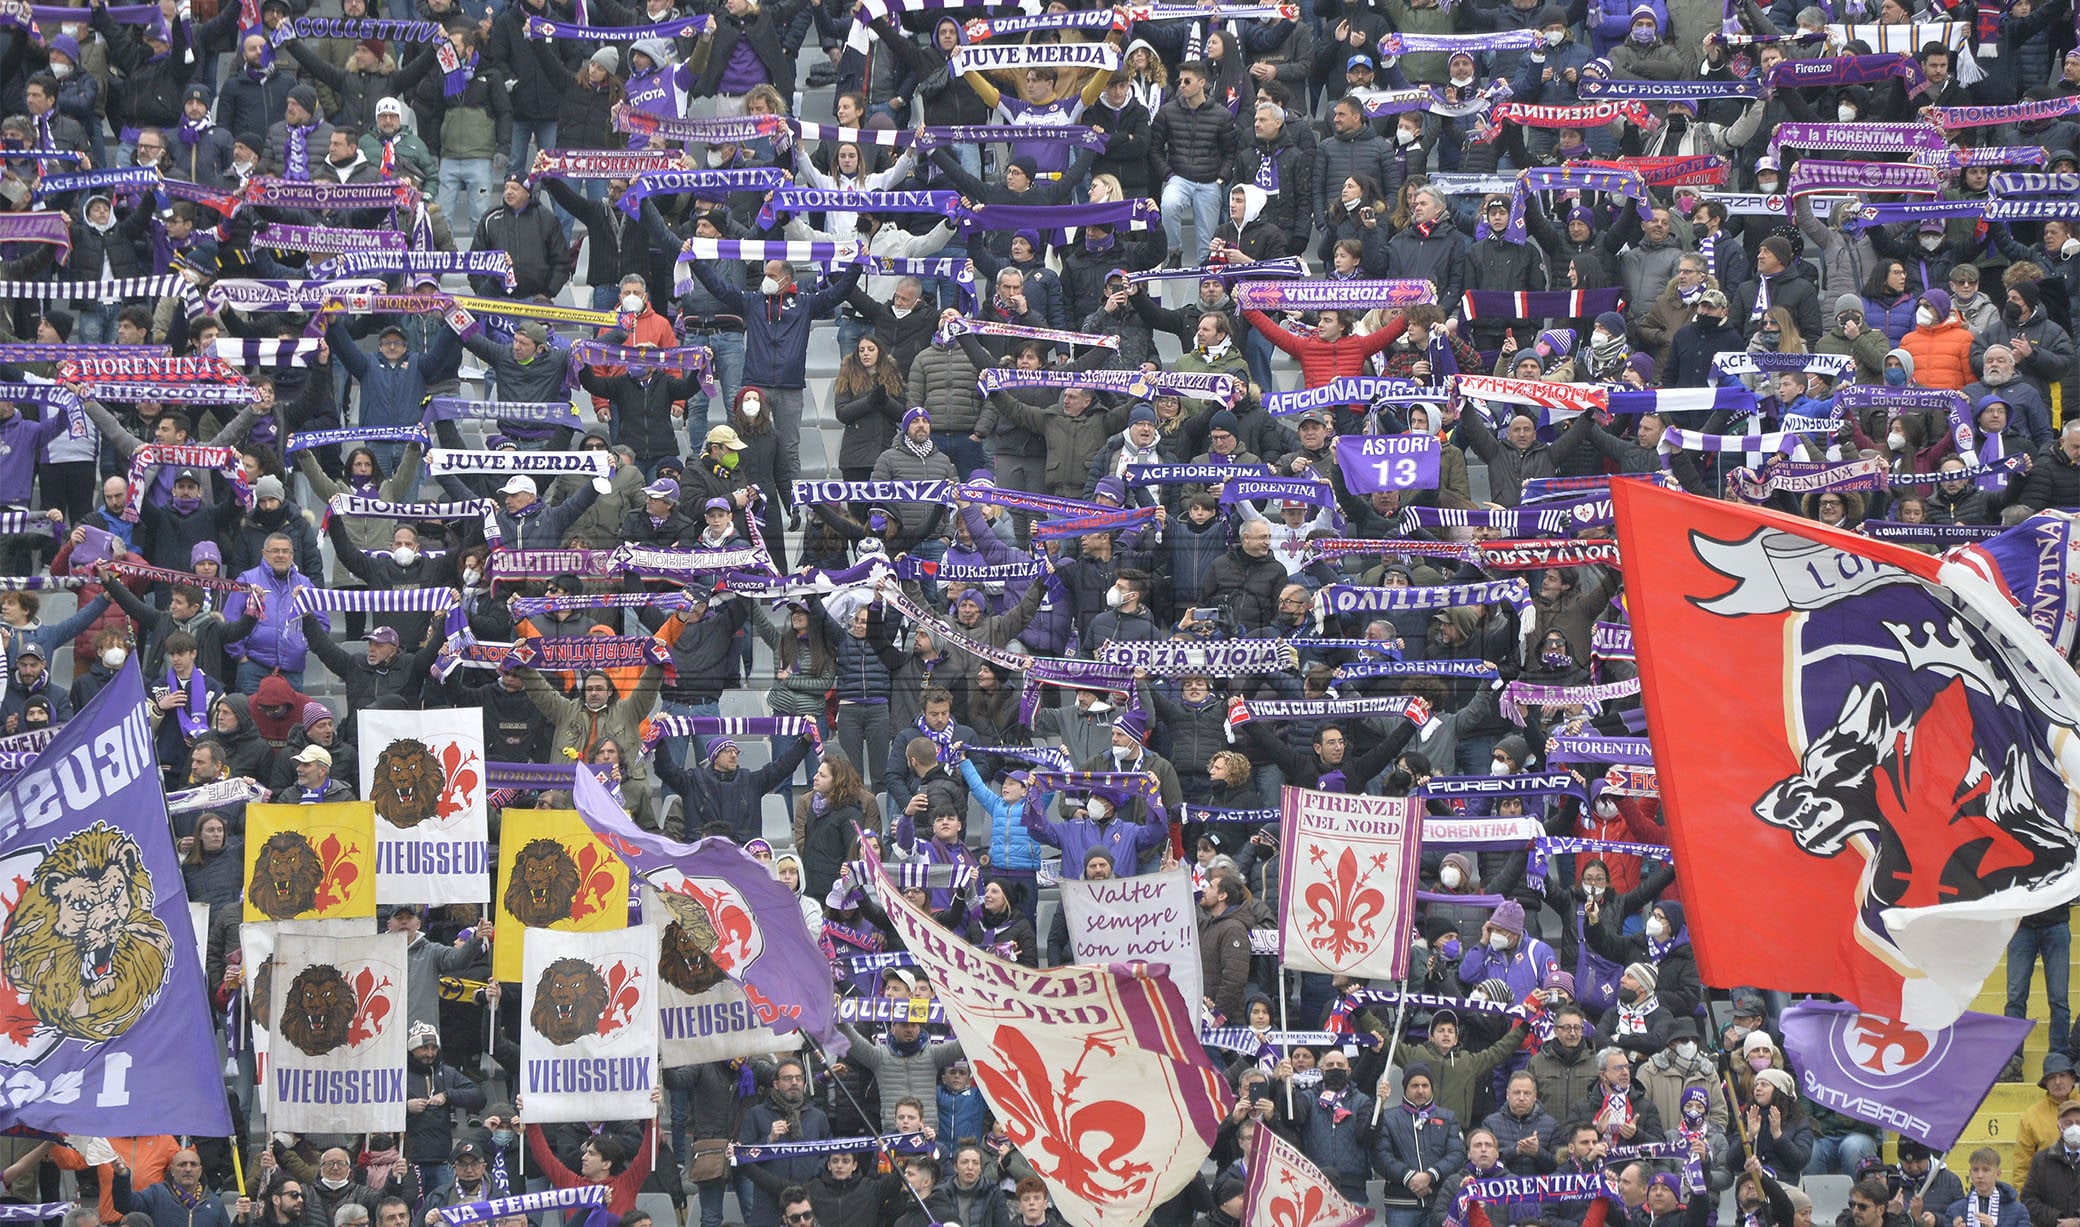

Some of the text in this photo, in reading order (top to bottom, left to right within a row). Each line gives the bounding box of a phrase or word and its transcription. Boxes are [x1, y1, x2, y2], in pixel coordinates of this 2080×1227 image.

[294, 17, 451, 42] COLLETTIV
[961, 44, 1106, 67] JUVE MERDA
[1795, 62, 1832, 74] Firenze
[630, 88, 667, 107] TOYOTA
[1607, 84, 1728, 95] ACF FIORENTINA
[1949, 96, 2072, 124] FIORENTINA
[660, 121, 757, 137] FIORENTINA
[1826, 129, 1905, 143] FIORENTINA
[43, 168, 159, 194] ACF FIORENTIN
[641, 170, 786, 192] FIORENTINA
[266, 183, 394, 204] Forza Fiorentina
[779, 194, 935, 209] FIORENTINA
[308, 231, 382, 249] FIORENTINA
[345, 250, 403, 271] FIRENZE
[408, 250, 451, 270] VANTO
[455, 251, 465, 269] E
[469, 251, 508, 271] GLOR
[376, 296, 446, 311] FIORENTIN
[1284, 286, 1390, 302] FIORENTINA
[81, 357, 213, 375] FIORENTINA
[1719, 354, 1747, 371] ACF
[1156, 371, 1212, 390] AGAZZI
[469, 402, 549, 419] QUINTO
[1871, 397, 1917, 408] CONTRO
[1783, 416, 1842, 431] FIORENTIN
[1362, 436, 1431, 457] ASTORI
[441, 453, 598, 472] JUVE MERDA
[1141, 466, 1261, 480] ACF FIORENTINA
[1371, 458, 1418, 487] 13
[1888, 463, 1993, 485] FIORENTINA
[1238, 482, 1317, 499] FIORENTINA
[1037, 507, 1154, 536] CF FIORENTIN
[1882, 527, 1937, 537] QUARTIERI,
[1945, 528, 1979, 537] CUORE
[1980, 529, 2001, 537] VIO
[492, 551, 583, 573] COLLETTIVO
[913, 560, 1039, 578] I FIORENTINA
[2031, 520, 2064, 641] ENTINA
[1337, 584, 1523, 611] COLLETTIVO
[543, 642, 645, 661] FIORENTINA
[1106, 648, 1278, 667] FORZA VIOLA
[1379, 662, 1475, 676] FIORENTINA
[1249, 696, 1408, 717] VIOLA CLUB AMSTERDAM
[1563, 740, 1653, 757] FIORENTIN
[488, 769, 575, 782] FIORENTIN
[1426, 775, 1572, 795] FIORENTINA
[1304, 793, 1402, 818] FIRENZE
[1245, 810, 1281, 821] FIOR
[1303, 813, 1400, 836] NEL NORD
[1422, 822, 1519, 839] FIORENTINA
[376, 841, 490, 875] VIEUSSEUX
[1087, 880, 1167, 905] Valter
[1085, 905, 1178, 934] sempre
[884, 896, 1098, 999] FIRENZE
[1077, 941, 1120, 958] con
[1127, 930, 1175, 956] noi
[850, 952, 902, 975] LUPI
[661, 1001, 759, 1040] VIEUSSE
[1275, 1032, 1328, 1040] FORENTINA
[528, 1057, 650, 1094] VIEUSSEUX
[277, 1067, 404, 1105] VIEUSSEUX
[1987, 1118, 1999, 1137] 6
[1466, 1174, 1602, 1198] FIORENTINA
[442, 1204, 479, 1224] VA
